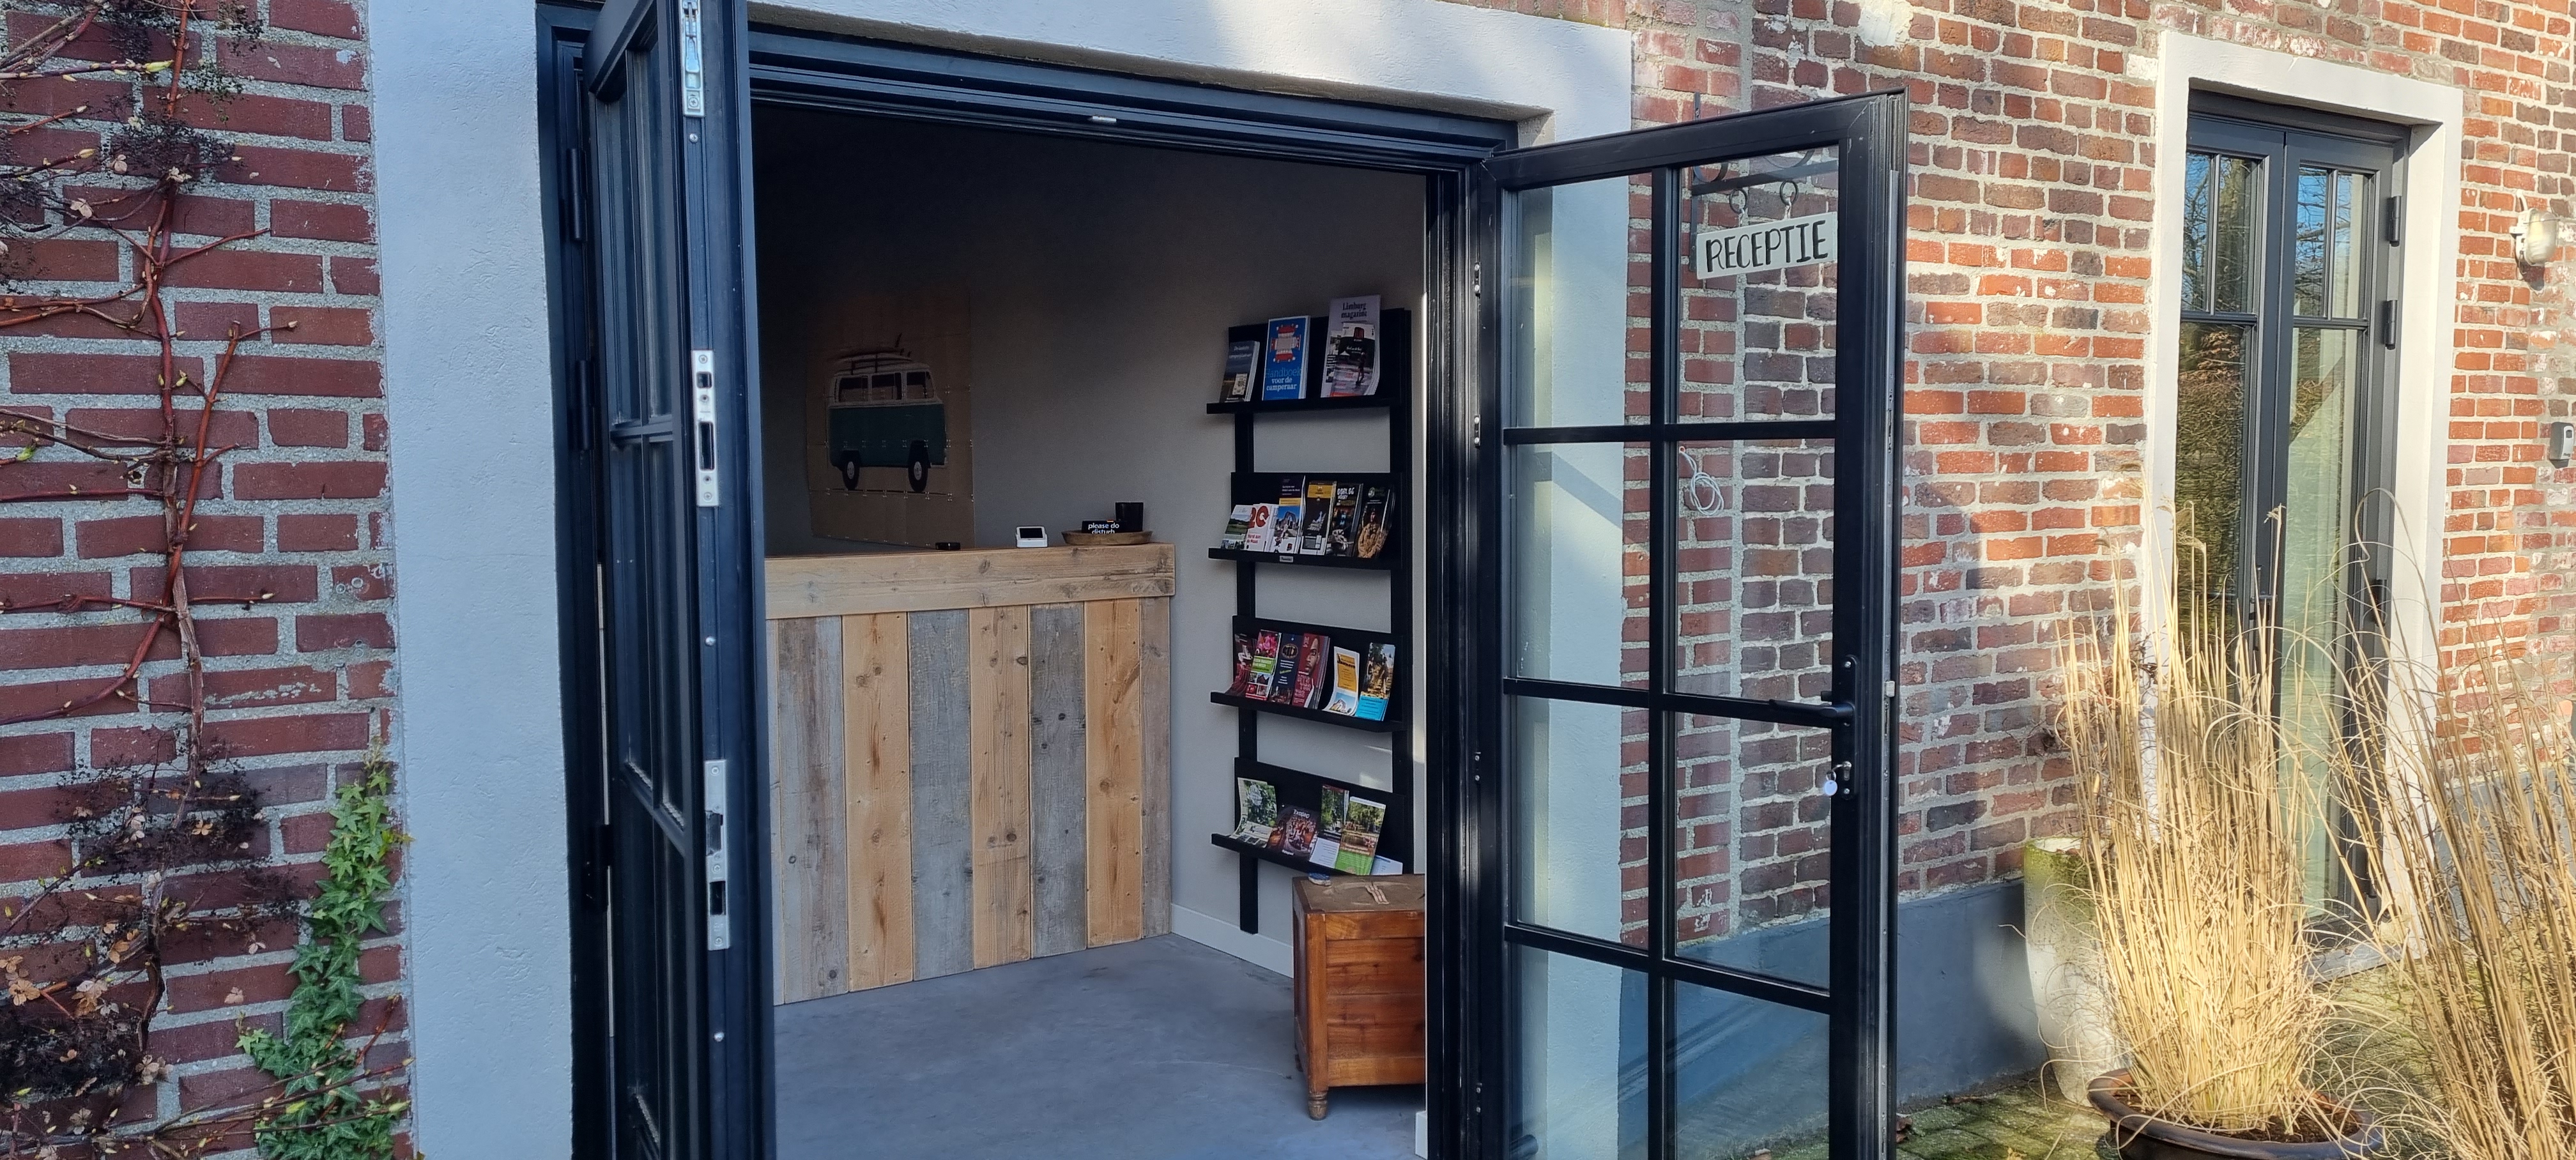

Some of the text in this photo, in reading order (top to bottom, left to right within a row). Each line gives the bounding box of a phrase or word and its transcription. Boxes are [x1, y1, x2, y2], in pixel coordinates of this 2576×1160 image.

[1706, 220, 1828, 273] RECEPTIE
[1342, 301, 1367, 310] Limburg
[1341, 309, 1367, 320] magazine
[1266, 366, 1301, 378] Handboek
[1087, 522, 1109, 530] please
